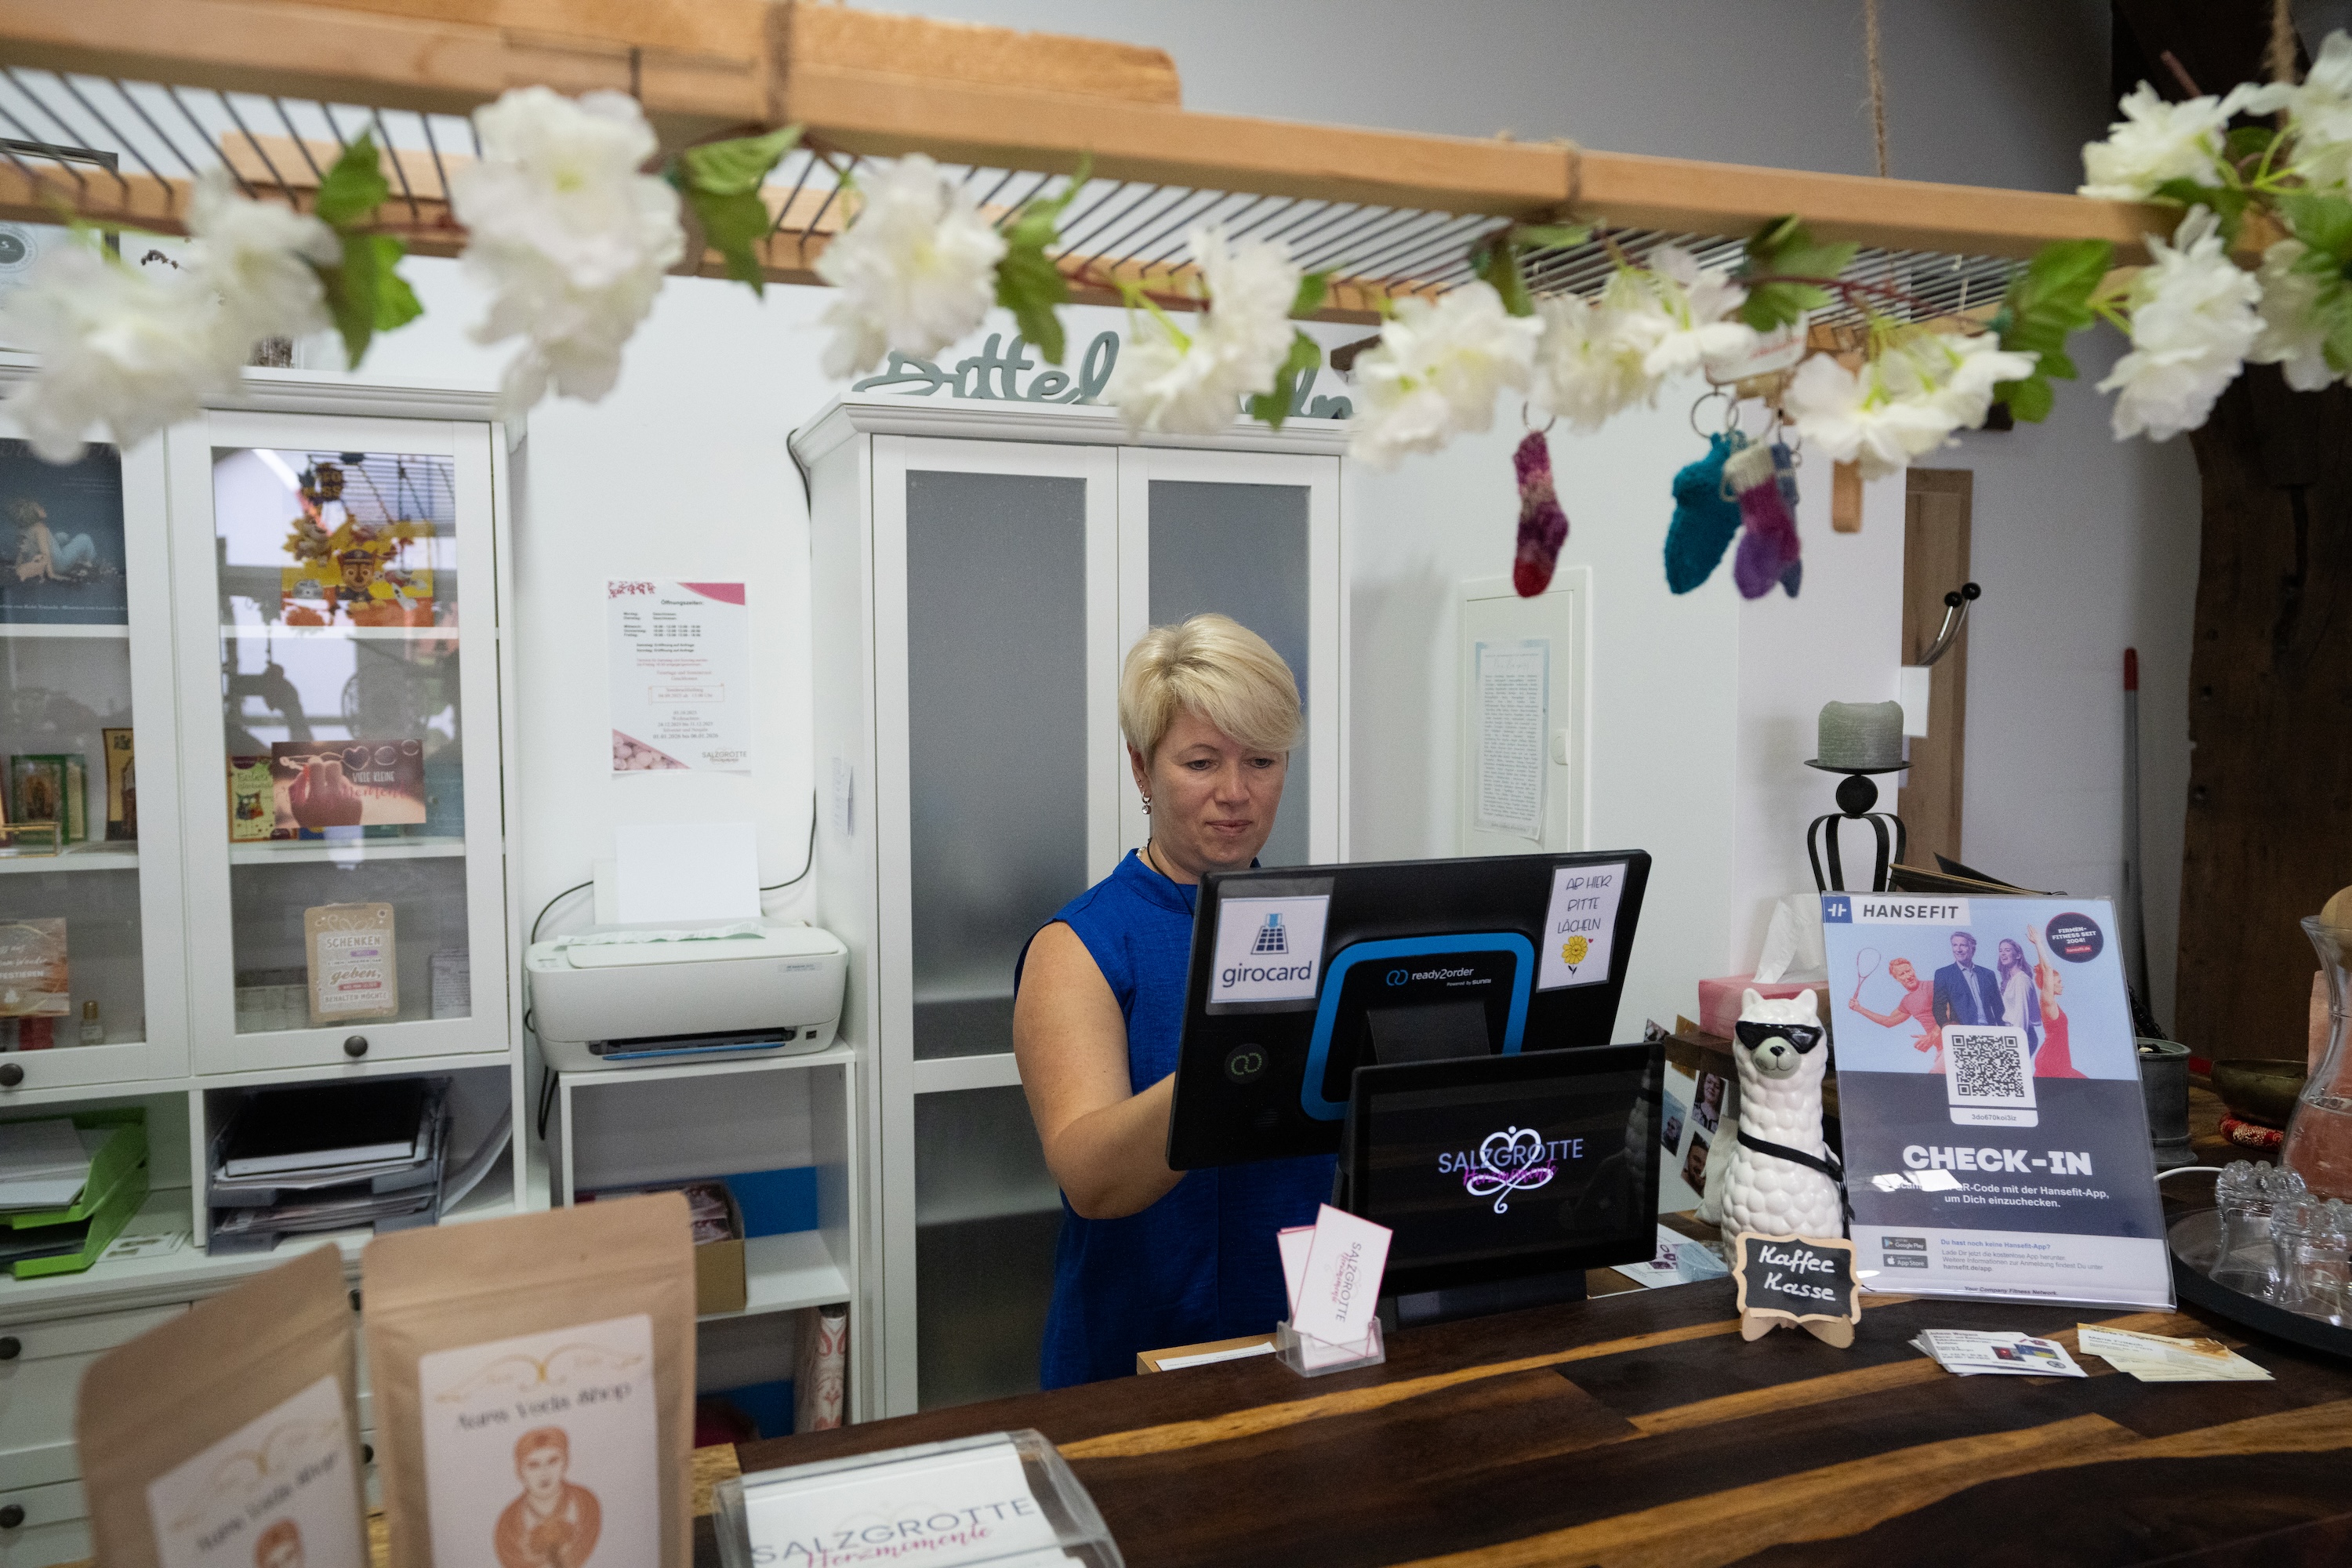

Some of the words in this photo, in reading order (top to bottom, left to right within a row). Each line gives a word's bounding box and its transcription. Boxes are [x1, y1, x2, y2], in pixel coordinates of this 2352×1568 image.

[353, 771, 370, 782] VIELE
[373, 771, 394, 782] KLEINE
[1566, 877, 1584, 890] AB
[1587, 875, 1612, 888] HIER
[1568, 897, 1600, 912] BITTE
[1863, 904, 1958, 919] HANSEFIT
[1558, 918, 1601, 934] LÄCHELN
[327, 936, 380, 948] SCHENKEN
[330, 967, 381, 985] geben,
[1222, 960, 1312, 988] girocard
[1412, 967, 1474, 980] ready2order
[325, 994, 358, 1003] BEHALTEN
[1438, 1138, 1584, 1174] SALZGROTTE
[1903, 1145, 2092, 1176] CHECK-IN
[1463, 1158, 1559, 1187] Herzmomente
[2002, 1185, 2019, 1193] mit
[2023, 1185, 2038, 1194] der
[2040, 1186, 2110, 1199] Hansefit-App,
[1963, 1195, 1986, 1204] Dich
[1988, 1196, 2061, 1207] einzuchecken.
[2004, 1242, 2050, 1250] Hansefit-App?
[1759, 1245, 1835, 1274] Kaffee
[1336, 1242, 1362, 1323] SALZGROTTE
[1764, 1272, 1836, 1301] Kasse
[752, 1497, 1036, 1563] SALZGROTTE
[807, 1523, 993, 1568] Herzmomente
